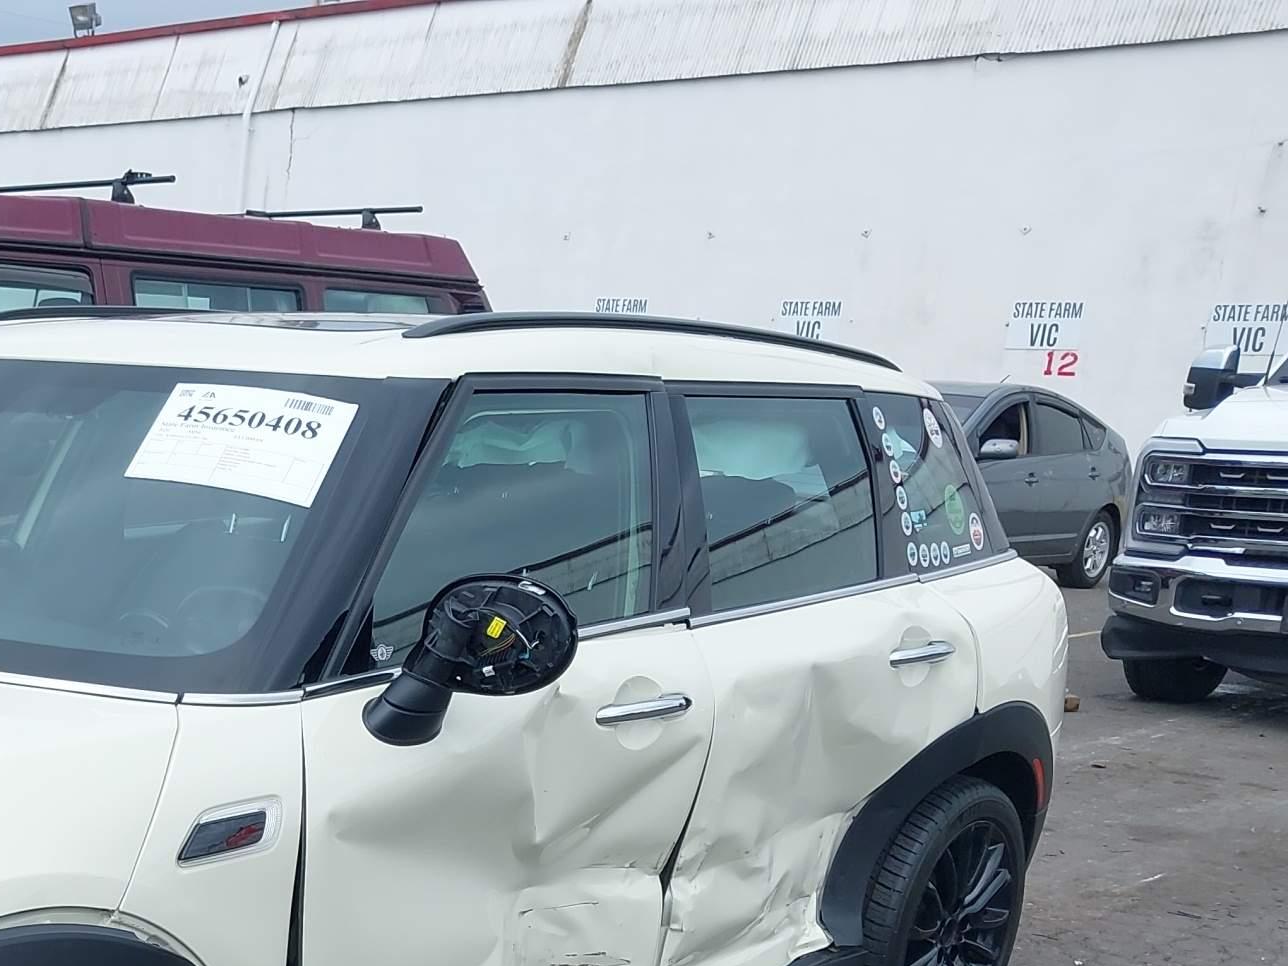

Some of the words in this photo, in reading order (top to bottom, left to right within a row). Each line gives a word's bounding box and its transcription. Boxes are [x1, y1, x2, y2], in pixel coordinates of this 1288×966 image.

[595, 298, 621, 313] STATE
[622, 298, 648, 313] FARM
[781, 301, 810, 316] STATE
[811, 301, 842, 316] FARM
[1013, 302, 1047, 319] STATE
[1048, 302, 1084, 319] FARM
[1213, 304, 1252, 322] STATE
[796, 320, 821, 339] VIC
[1029, 323, 1059, 347] VIC
[1233, 326, 1266, 352] VIC
[1043, 351, 1079, 377] 12
[177, 405, 322, 440] 45650408
